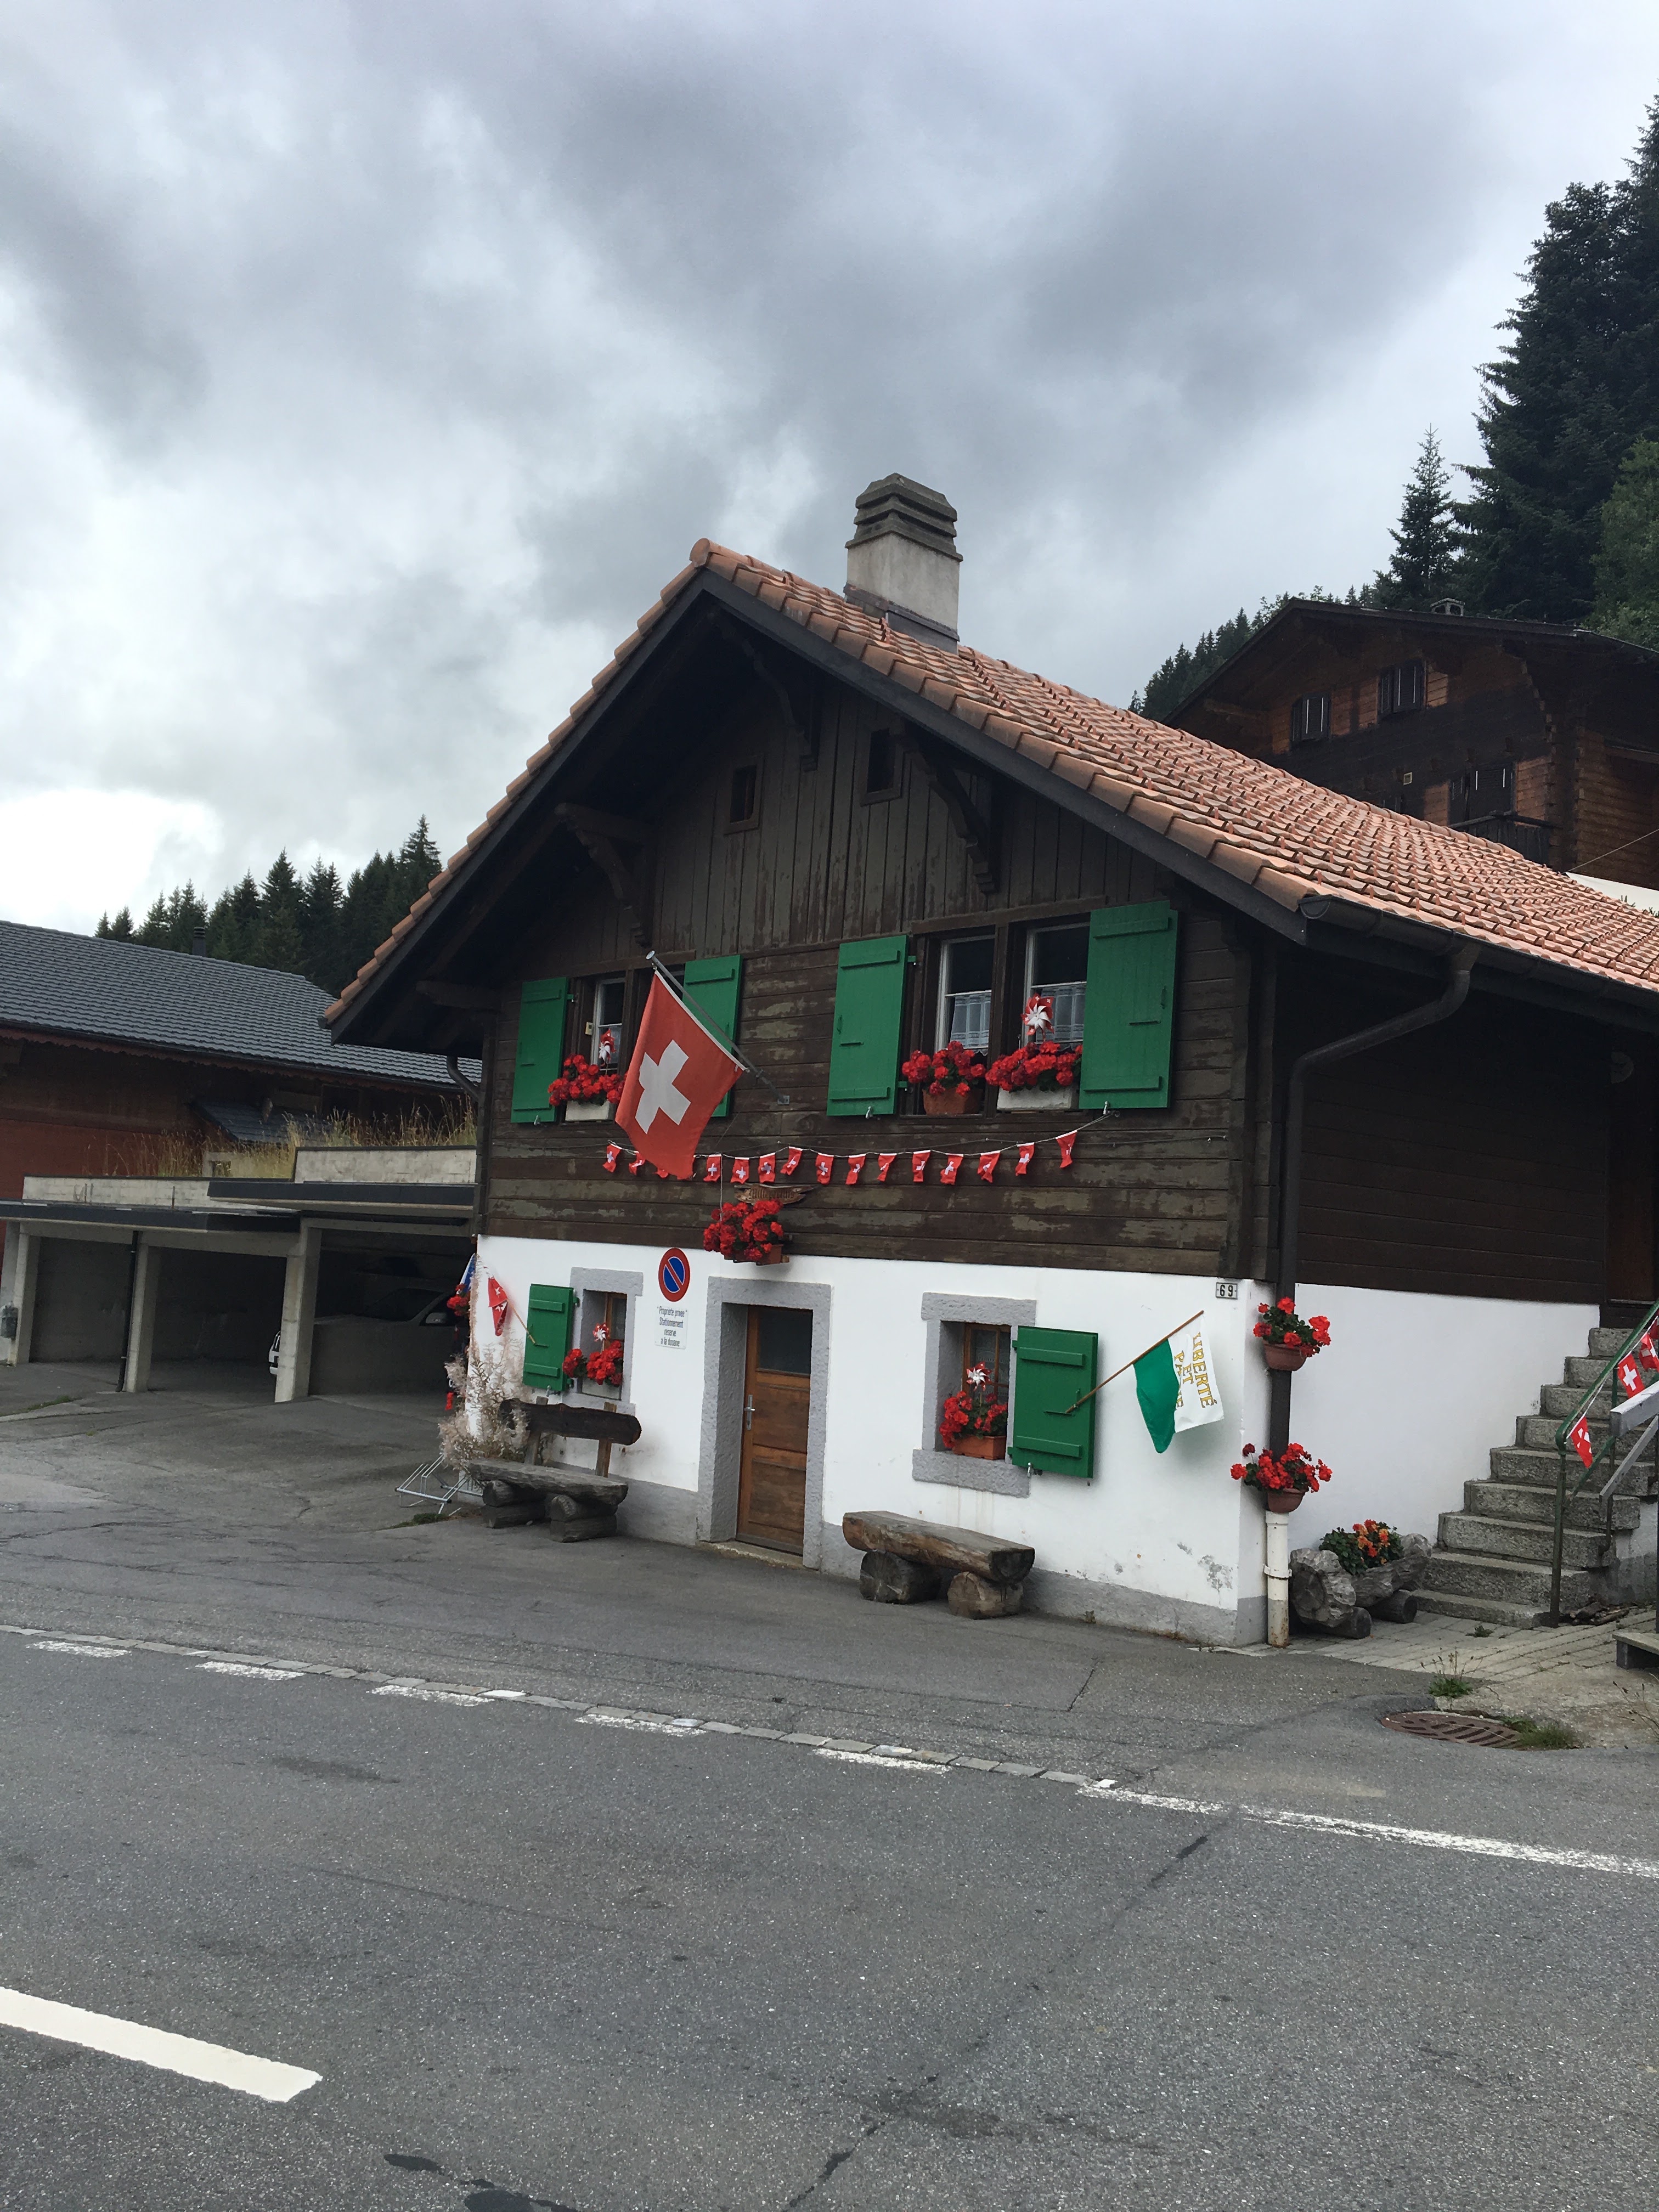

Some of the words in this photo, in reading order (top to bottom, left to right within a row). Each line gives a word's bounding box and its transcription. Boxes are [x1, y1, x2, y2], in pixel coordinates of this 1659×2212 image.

[1220, 1284, 1233, 1297] 69
[1182, 1363, 1194, 1385] ET
[1192, 1331, 1217, 1408] LIBERTÉ
